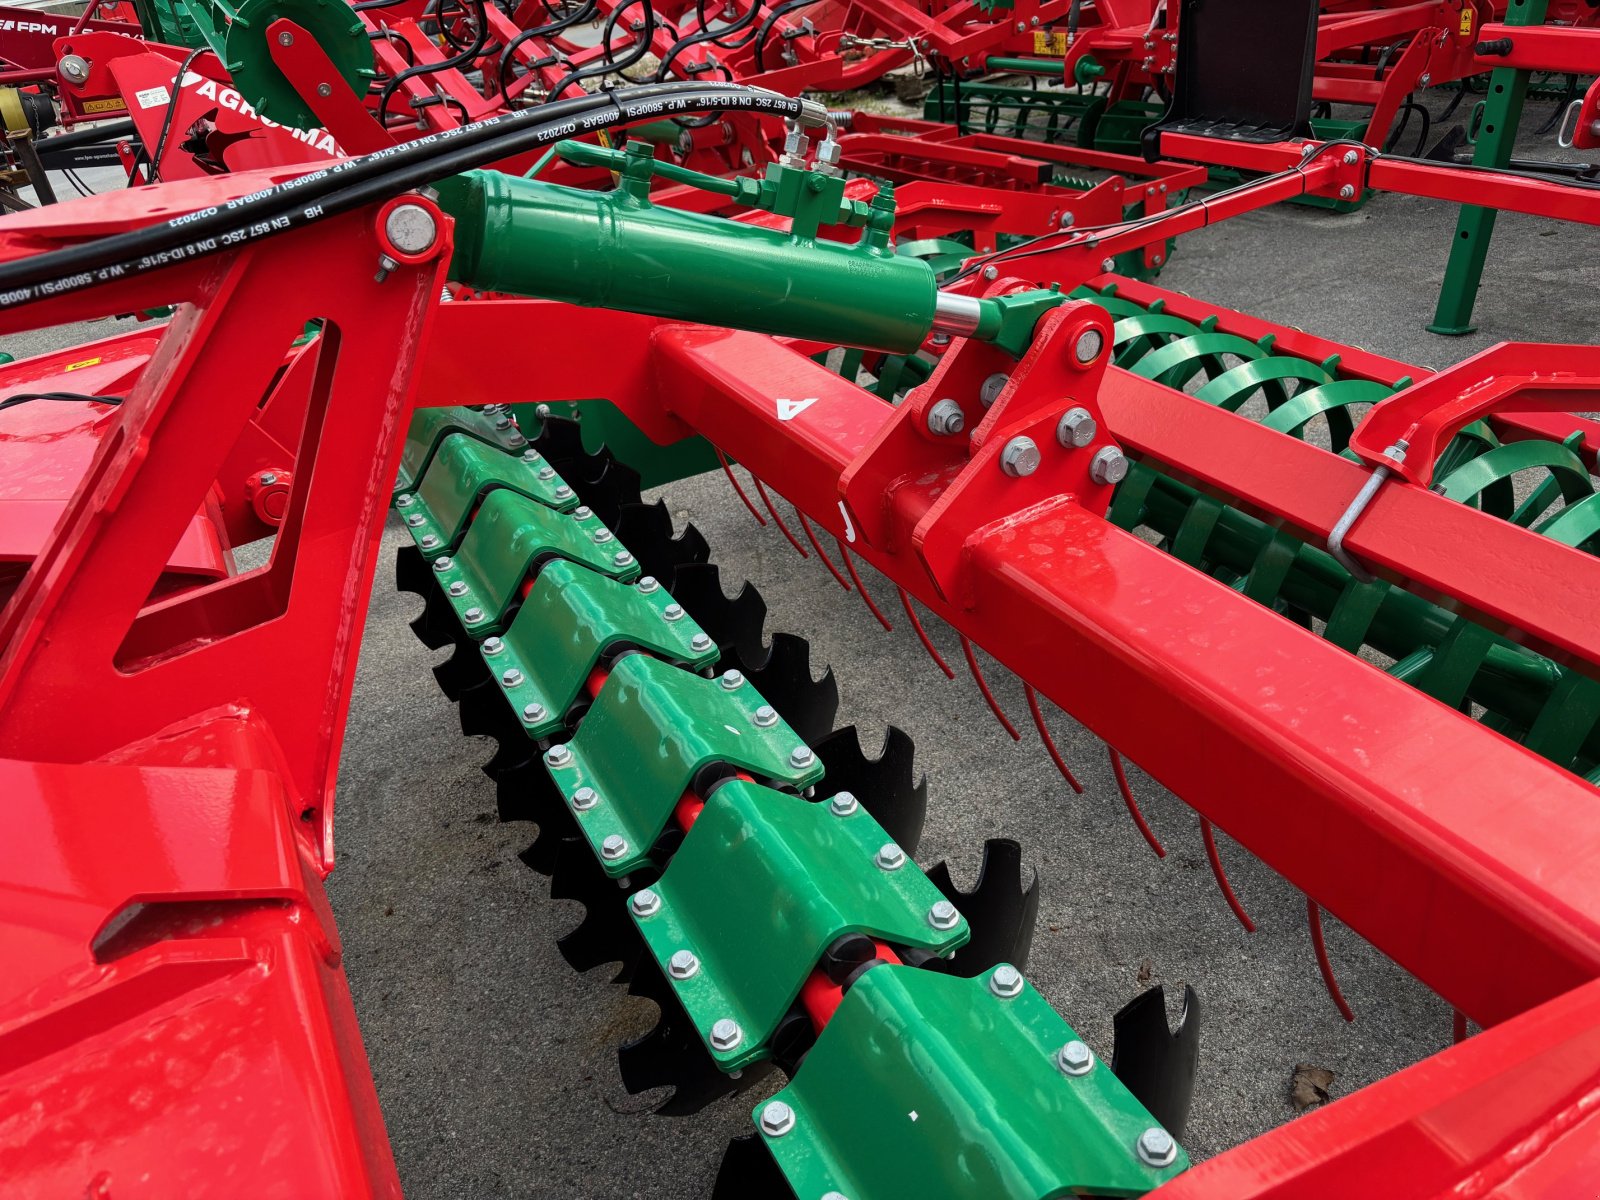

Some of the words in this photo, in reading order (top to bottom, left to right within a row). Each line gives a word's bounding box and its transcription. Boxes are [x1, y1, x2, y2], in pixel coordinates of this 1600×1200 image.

[17, 21, 57, 35] FPM
[732, 96, 737, 105] 8
[739, 96, 752, 106] DN
[756, 97, 772, 107] 2SC
[773, 99, 786, 110] 857
[787, 102, 798, 112] EN
[512, 110, 529, 118] HB
[626, 102, 663, 118] 5800PSI
[196, 81, 348, 159] AGR-MA
[465, 121, 483, 131] 857
[484, 117, 500, 126] EN
[582, 111, 620, 128] 400BAR
[441, 127, 463, 139] 2SC
[537, 123, 576, 142] Q2/2023
[411, 140, 418, 148] 8
[420, 134, 437, 146] DN
[281, 169, 328, 191] 5800PSI
[226, 188, 273, 209] 400BAR
[168, 206, 218, 227] Q2/2023
[303, 204, 324, 219] HB
[250, 222, 270, 237] 857
[271, 215, 291, 230] EN
[221, 229, 247, 245] 2SC
[186, 244, 195, 255] 8
[196, 238, 217, 252] DN
[41, 273, 92, 294] 5800PSI
